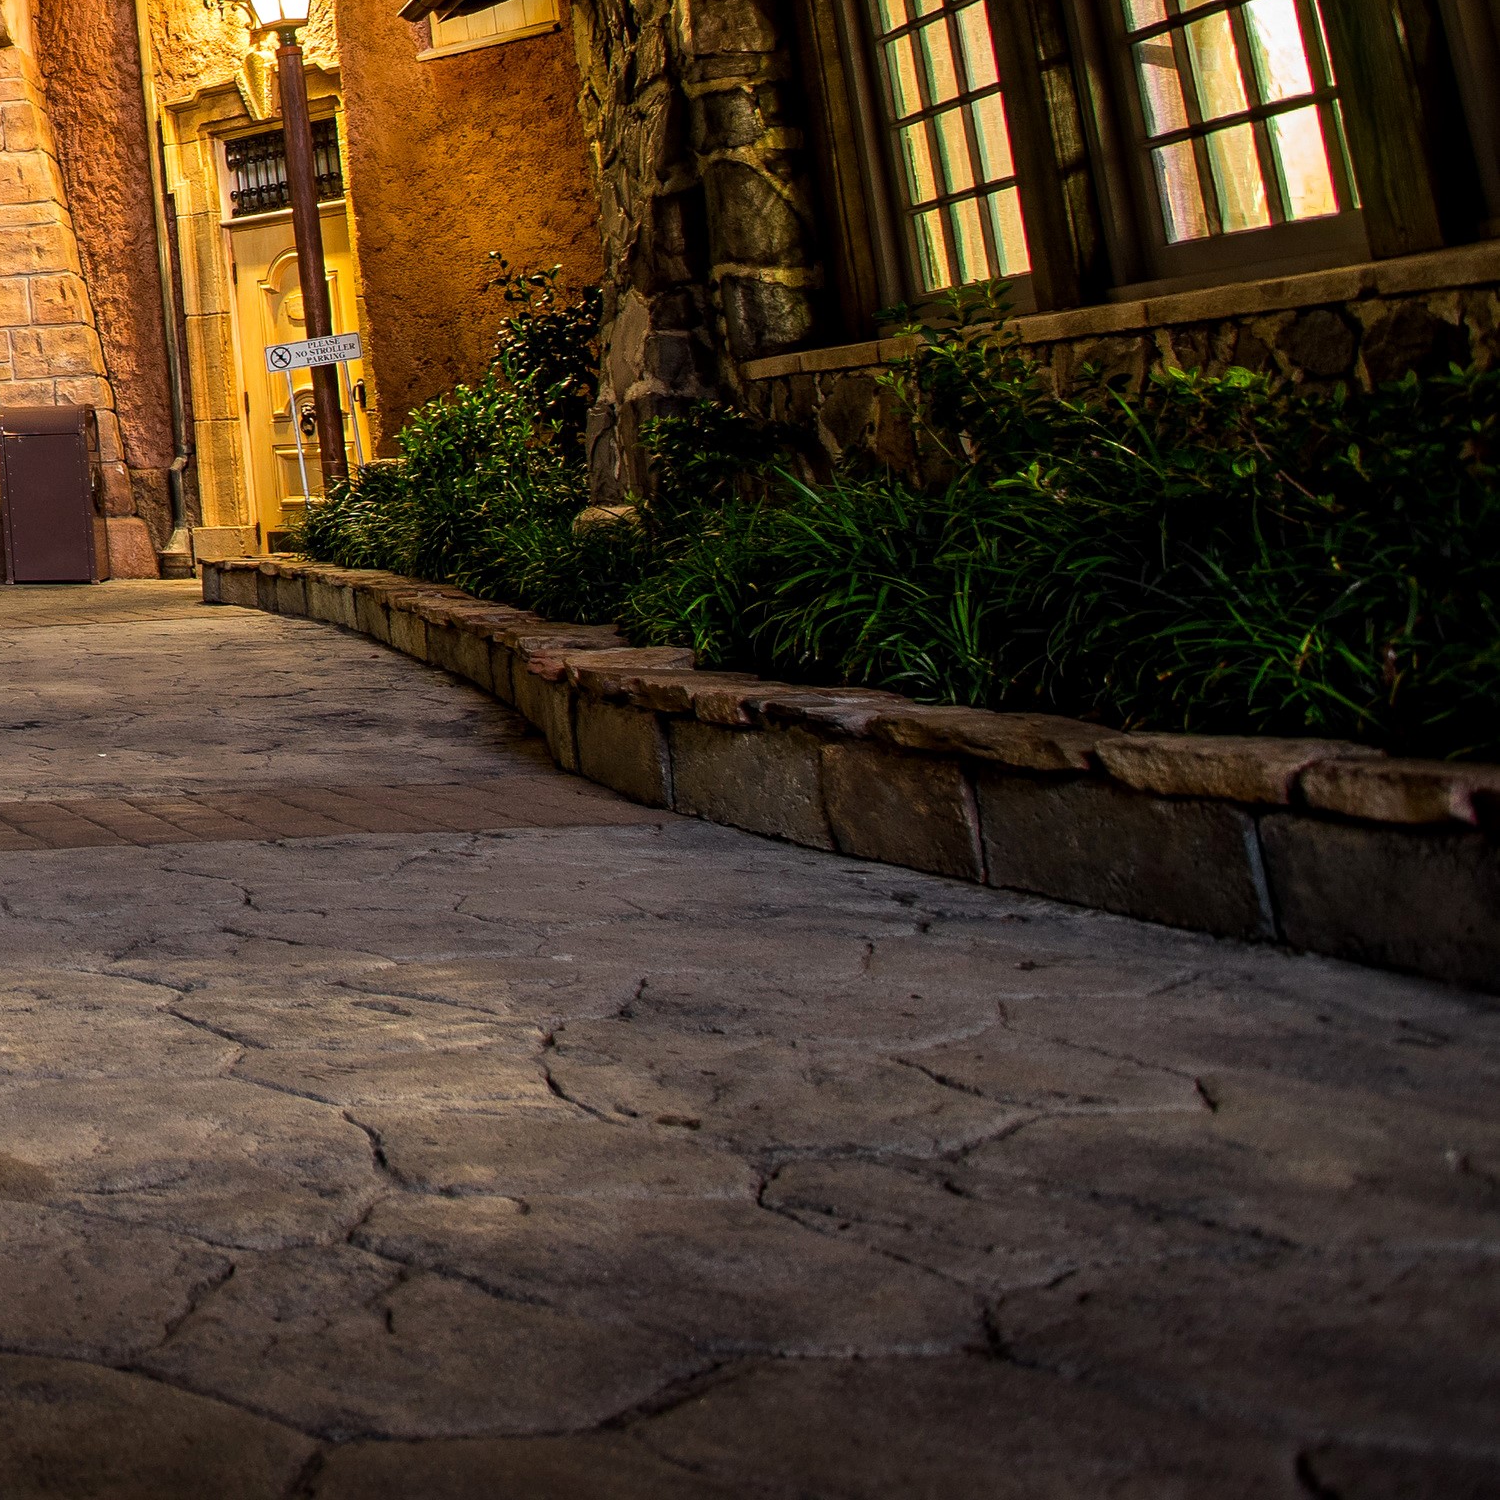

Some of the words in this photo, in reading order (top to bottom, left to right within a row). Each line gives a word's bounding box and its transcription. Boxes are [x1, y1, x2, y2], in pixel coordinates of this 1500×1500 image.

[308, 338, 340, 348] PLEASE
[310, 343, 355, 355] STROLLER
[307, 353, 345, 363] PARKING
